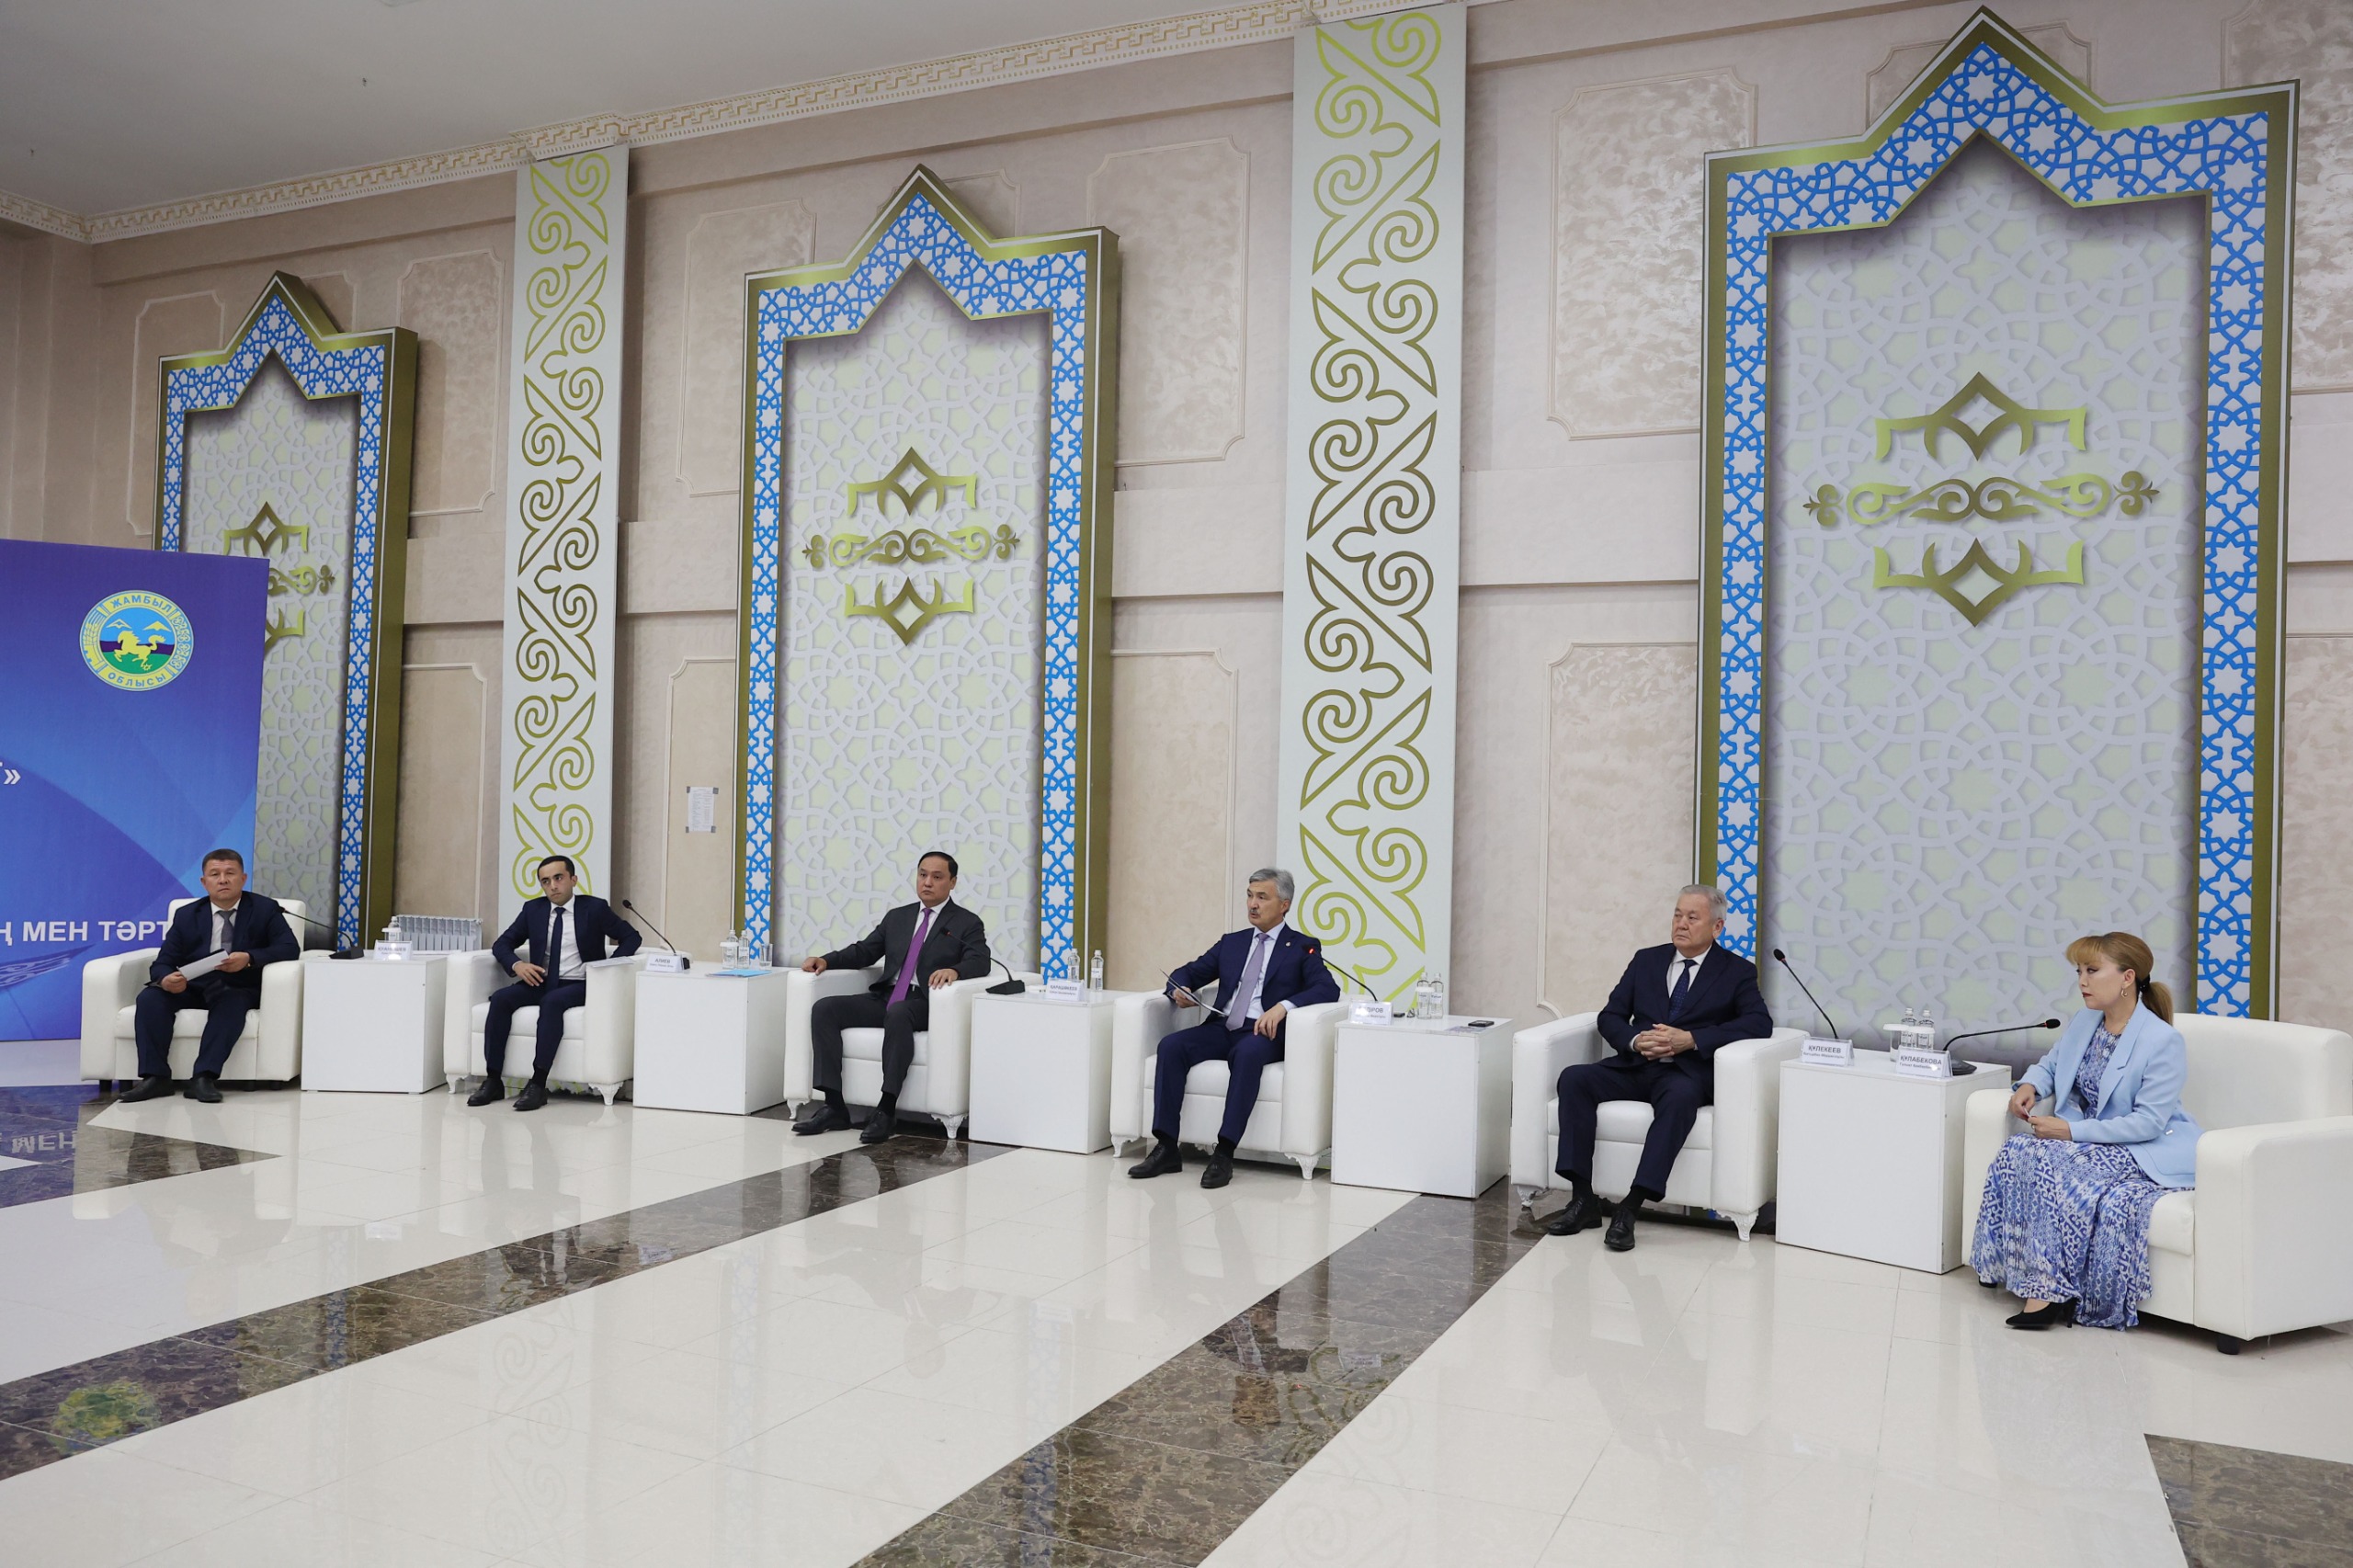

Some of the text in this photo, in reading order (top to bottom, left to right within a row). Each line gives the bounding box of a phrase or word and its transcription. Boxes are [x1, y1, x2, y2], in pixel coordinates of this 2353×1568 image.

[110, 595, 172, 612] ЖАМБЫЛ
[108, 672, 166, 687] ОБЛЫСЫ
[22, 921, 88, 942] МЕН
